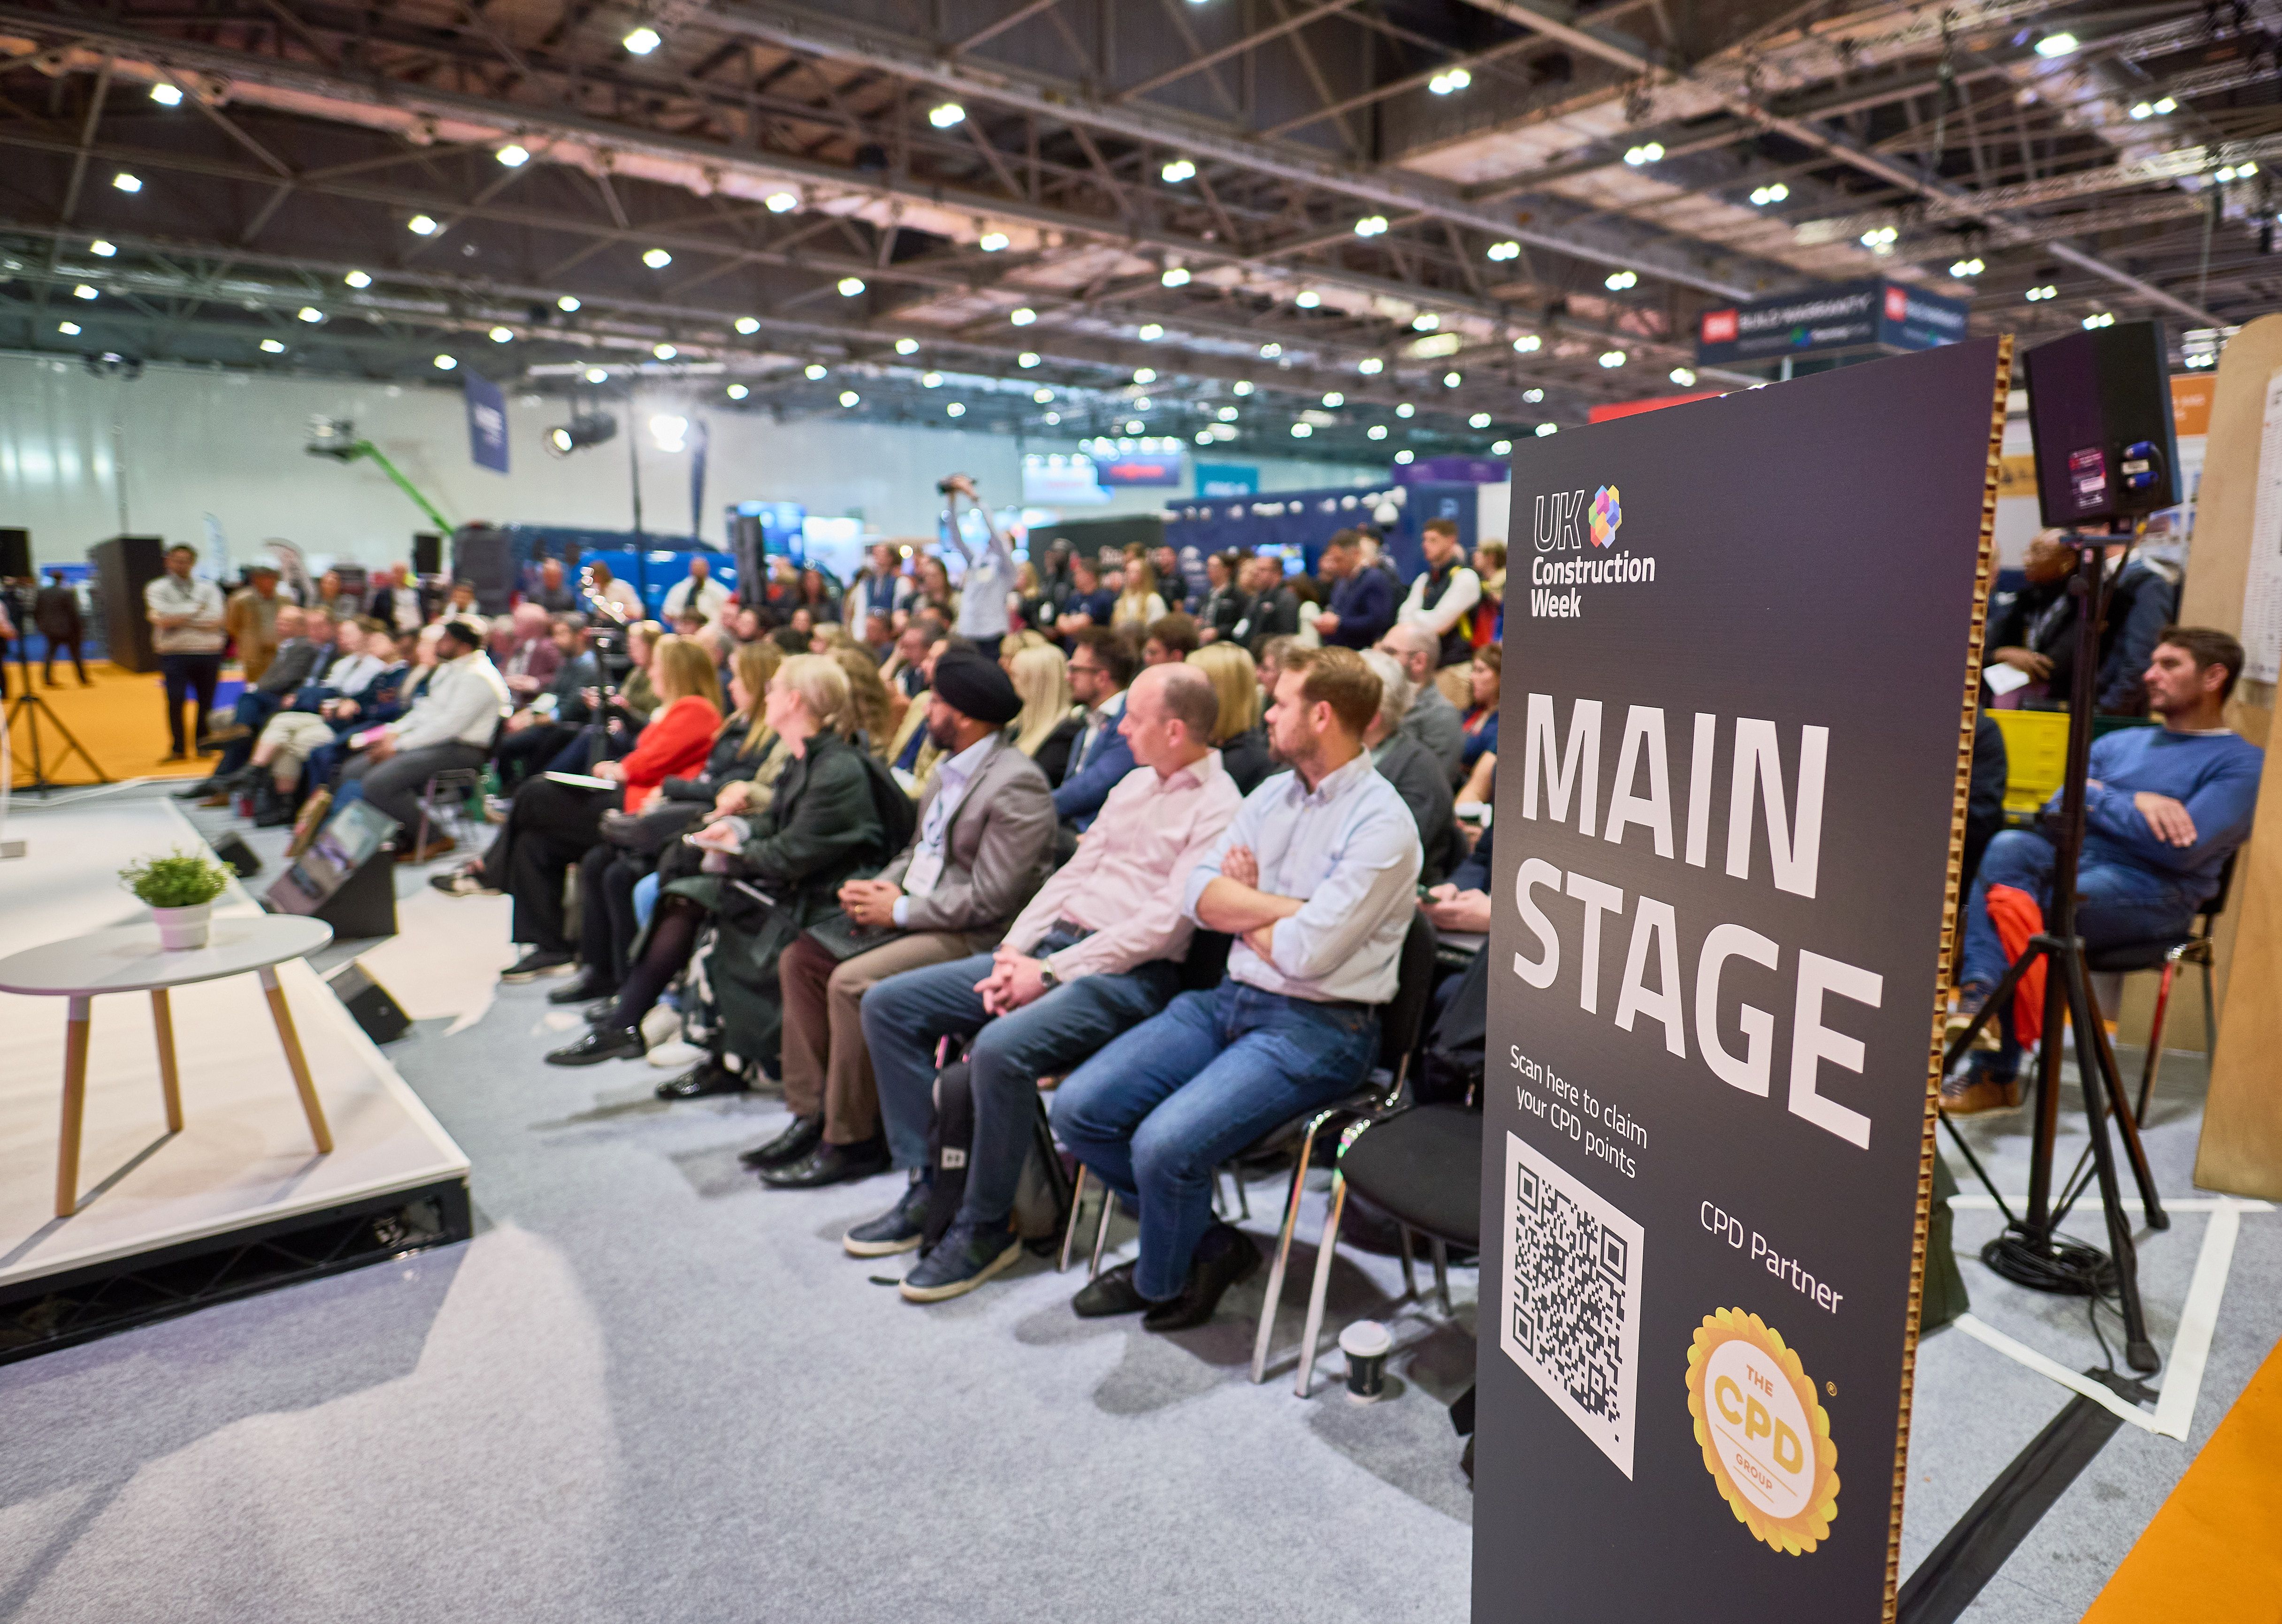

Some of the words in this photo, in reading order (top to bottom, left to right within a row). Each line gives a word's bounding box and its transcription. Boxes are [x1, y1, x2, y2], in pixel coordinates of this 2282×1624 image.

[1532, 549, 1656, 586] Construction
[1534, 489, 1585, 553] UK
[1530, 587, 1582, 618] Week
[1521, 692, 1830, 900] MAIN
[1512, 857, 1884, 1151] STAGE
[1509, 1044, 1543, 1084] Scan
[1546, 1064, 1579, 1107] here
[1583, 1088, 1600, 1119] to
[1604, 1104, 1647, 1150] claim
[1516, 1085, 1548, 1119] your
[1550, 1103, 1581, 1141] CPD
[1585, 1130, 1636, 1179] points
[1700, 1200, 1744, 1249] CPD
[1751, 1231, 1844, 1314] Partner
[1714, 1374, 1804, 1475] CPD
[1746, 1364, 1774, 1397] THE
[1736, 1452, 1773, 1490] GROUP
